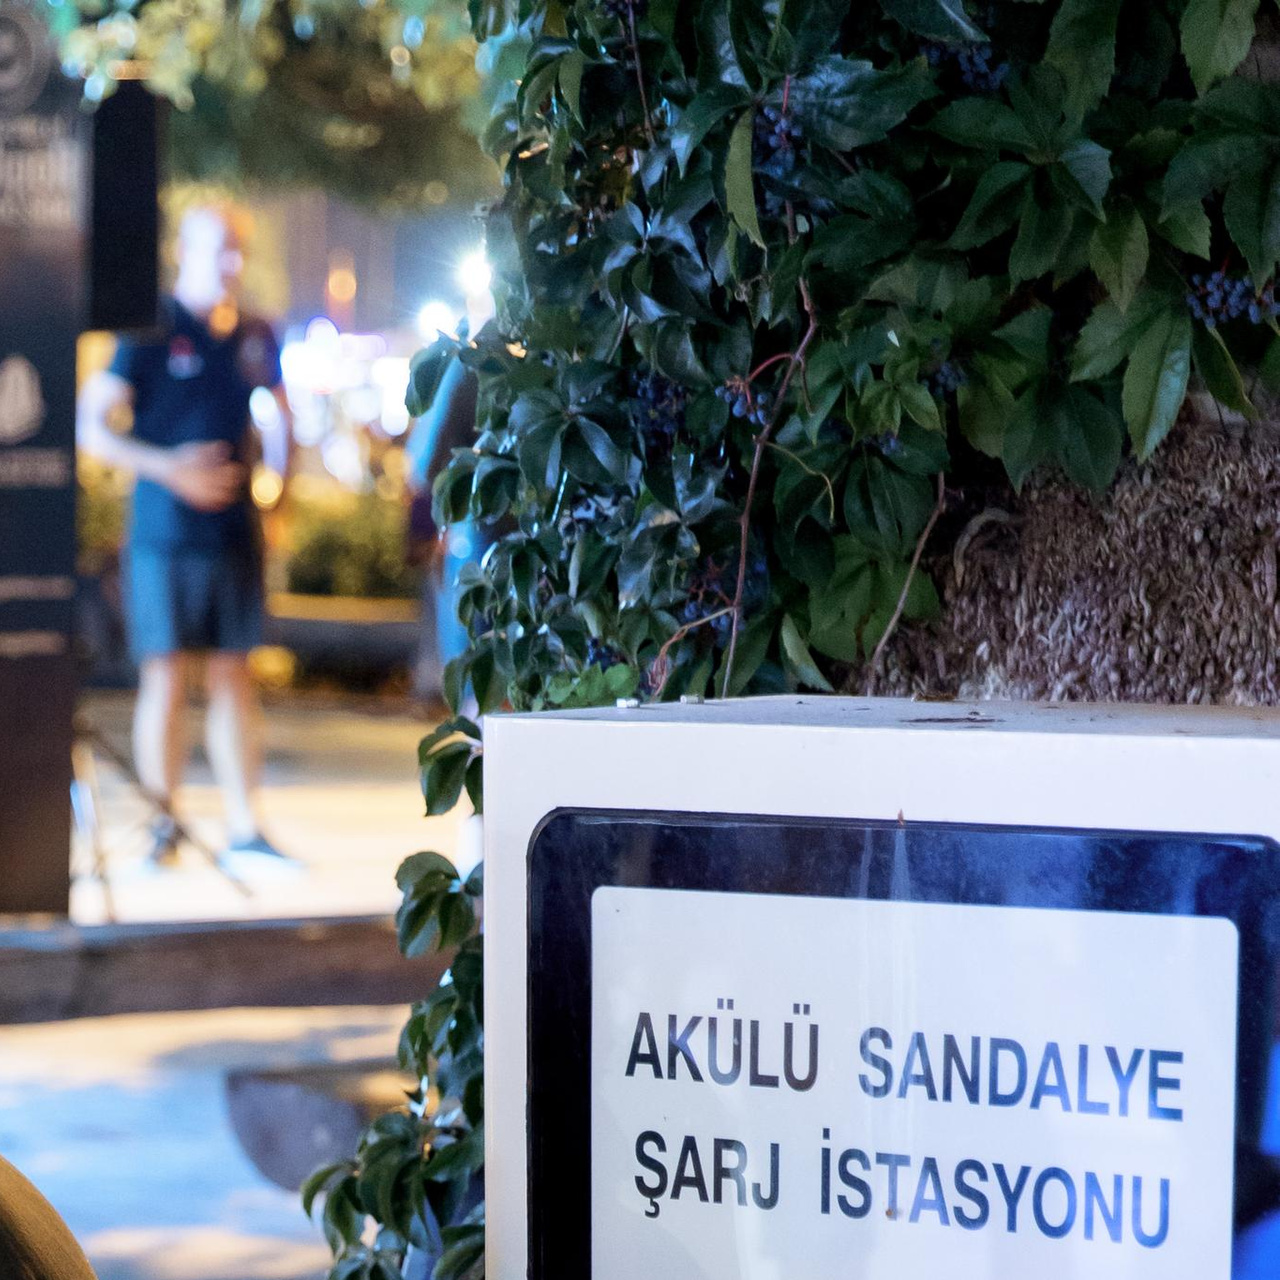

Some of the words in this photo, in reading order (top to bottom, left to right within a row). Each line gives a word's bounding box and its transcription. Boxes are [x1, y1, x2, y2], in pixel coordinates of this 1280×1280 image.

[625, 998, 819, 1092] AKÜLÜ
[858, 1027, 1184, 1122] SANDALYE
[634, 1130, 780, 1218] ŞARJ
[821, 1127, 1170, 1249] İSTASYONU
